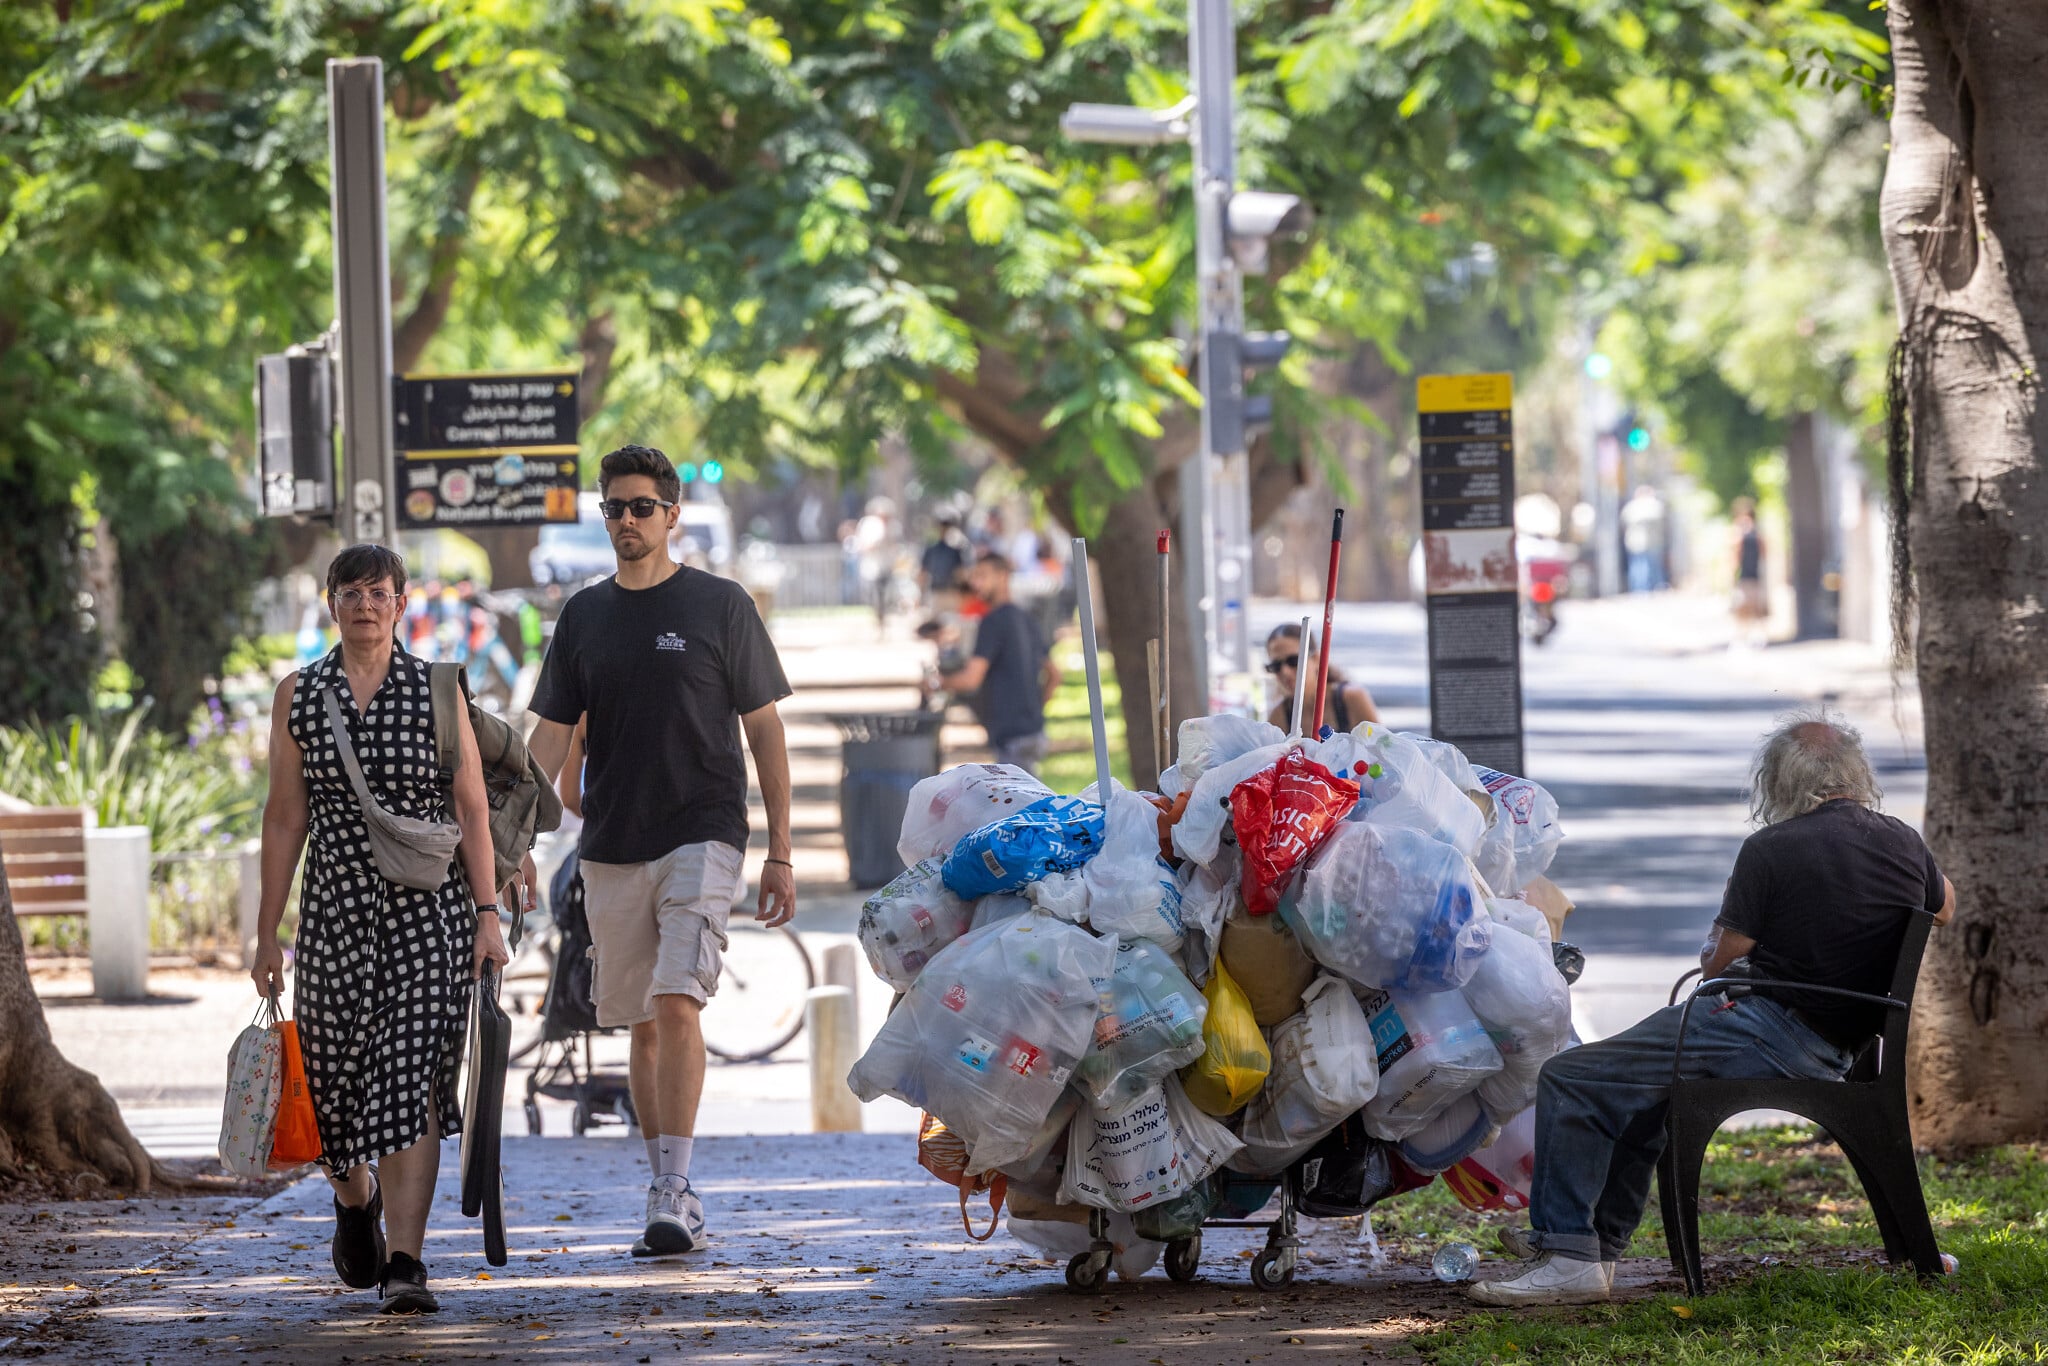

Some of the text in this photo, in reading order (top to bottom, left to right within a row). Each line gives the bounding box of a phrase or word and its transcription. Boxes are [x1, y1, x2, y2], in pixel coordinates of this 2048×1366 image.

[446, 423, 556, 442] Carmel Market
[1129, 1102, 1160, 1122] סלולר
[1133, 1119, 1158, 1136] אלפי
